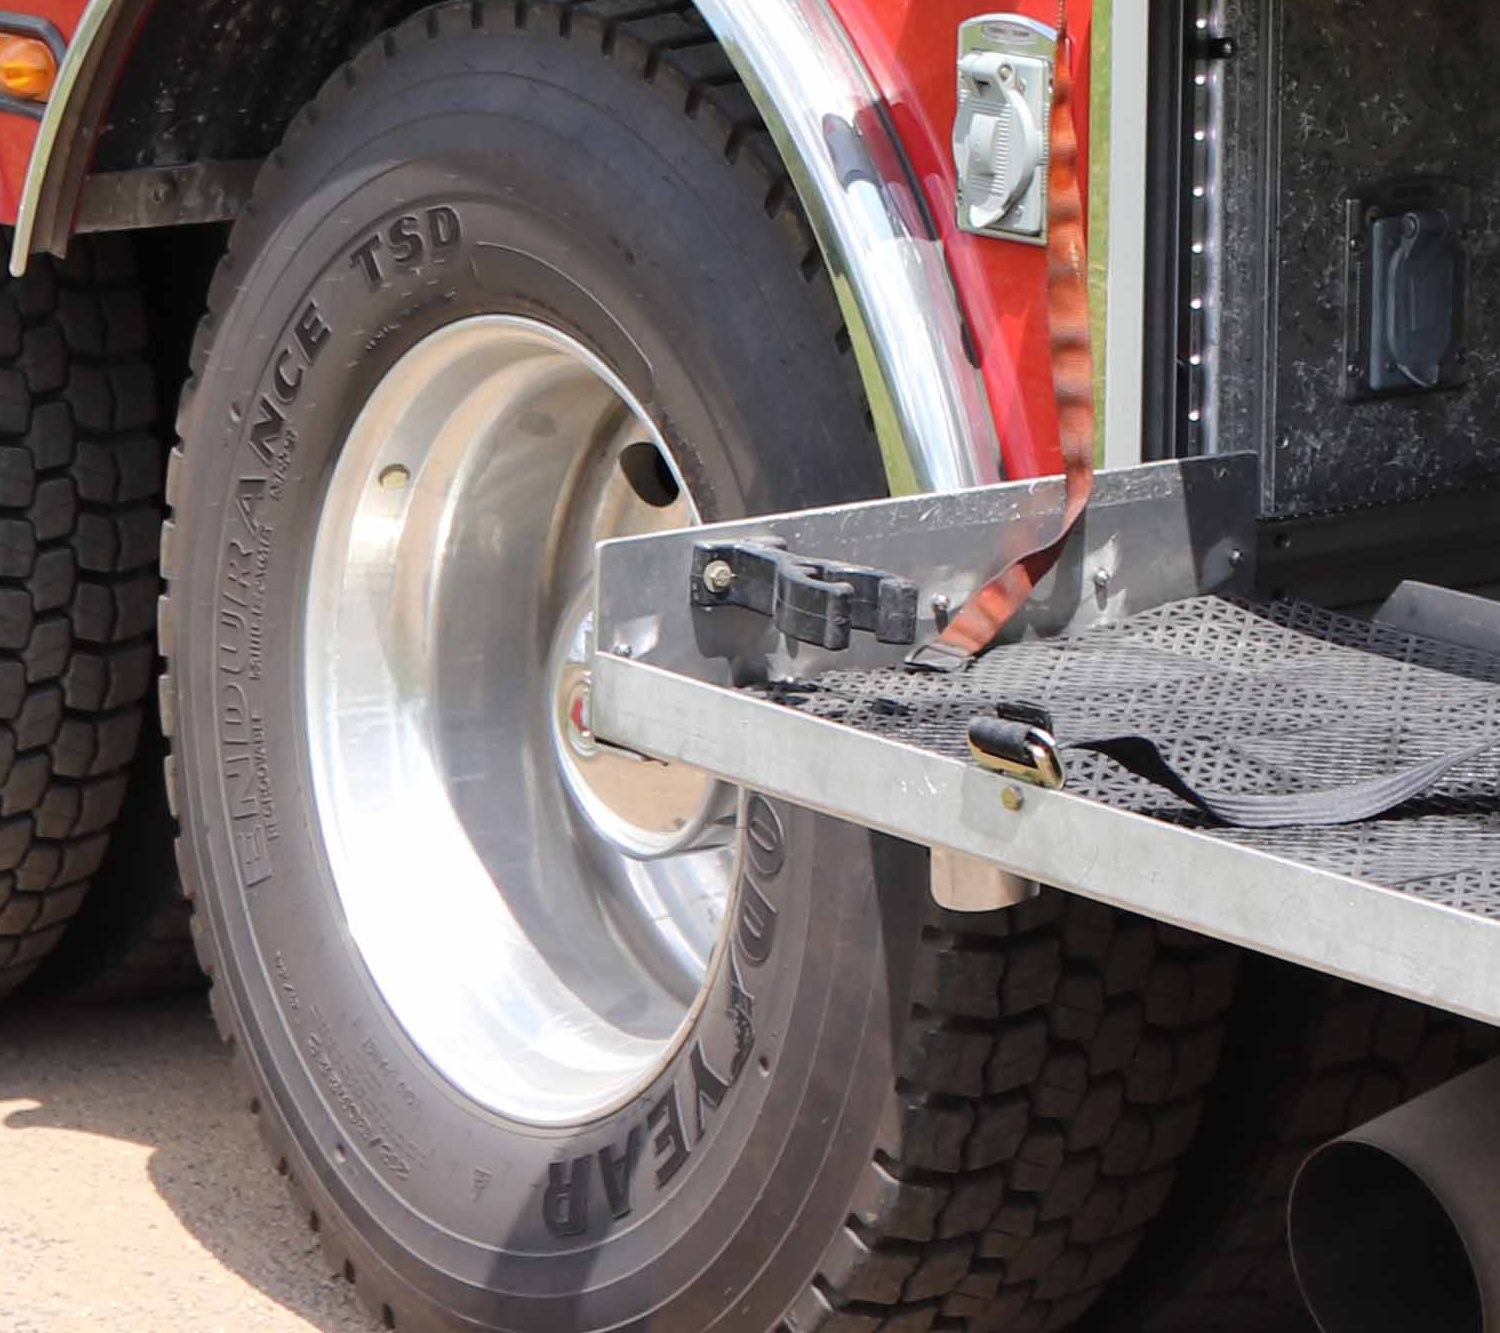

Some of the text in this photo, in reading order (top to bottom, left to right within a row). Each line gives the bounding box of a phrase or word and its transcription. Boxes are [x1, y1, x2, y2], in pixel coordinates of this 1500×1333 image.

[219, 204, 463, 888] ENDURANCE TSD
[543, 791, 784, 1237] ODYEAR
